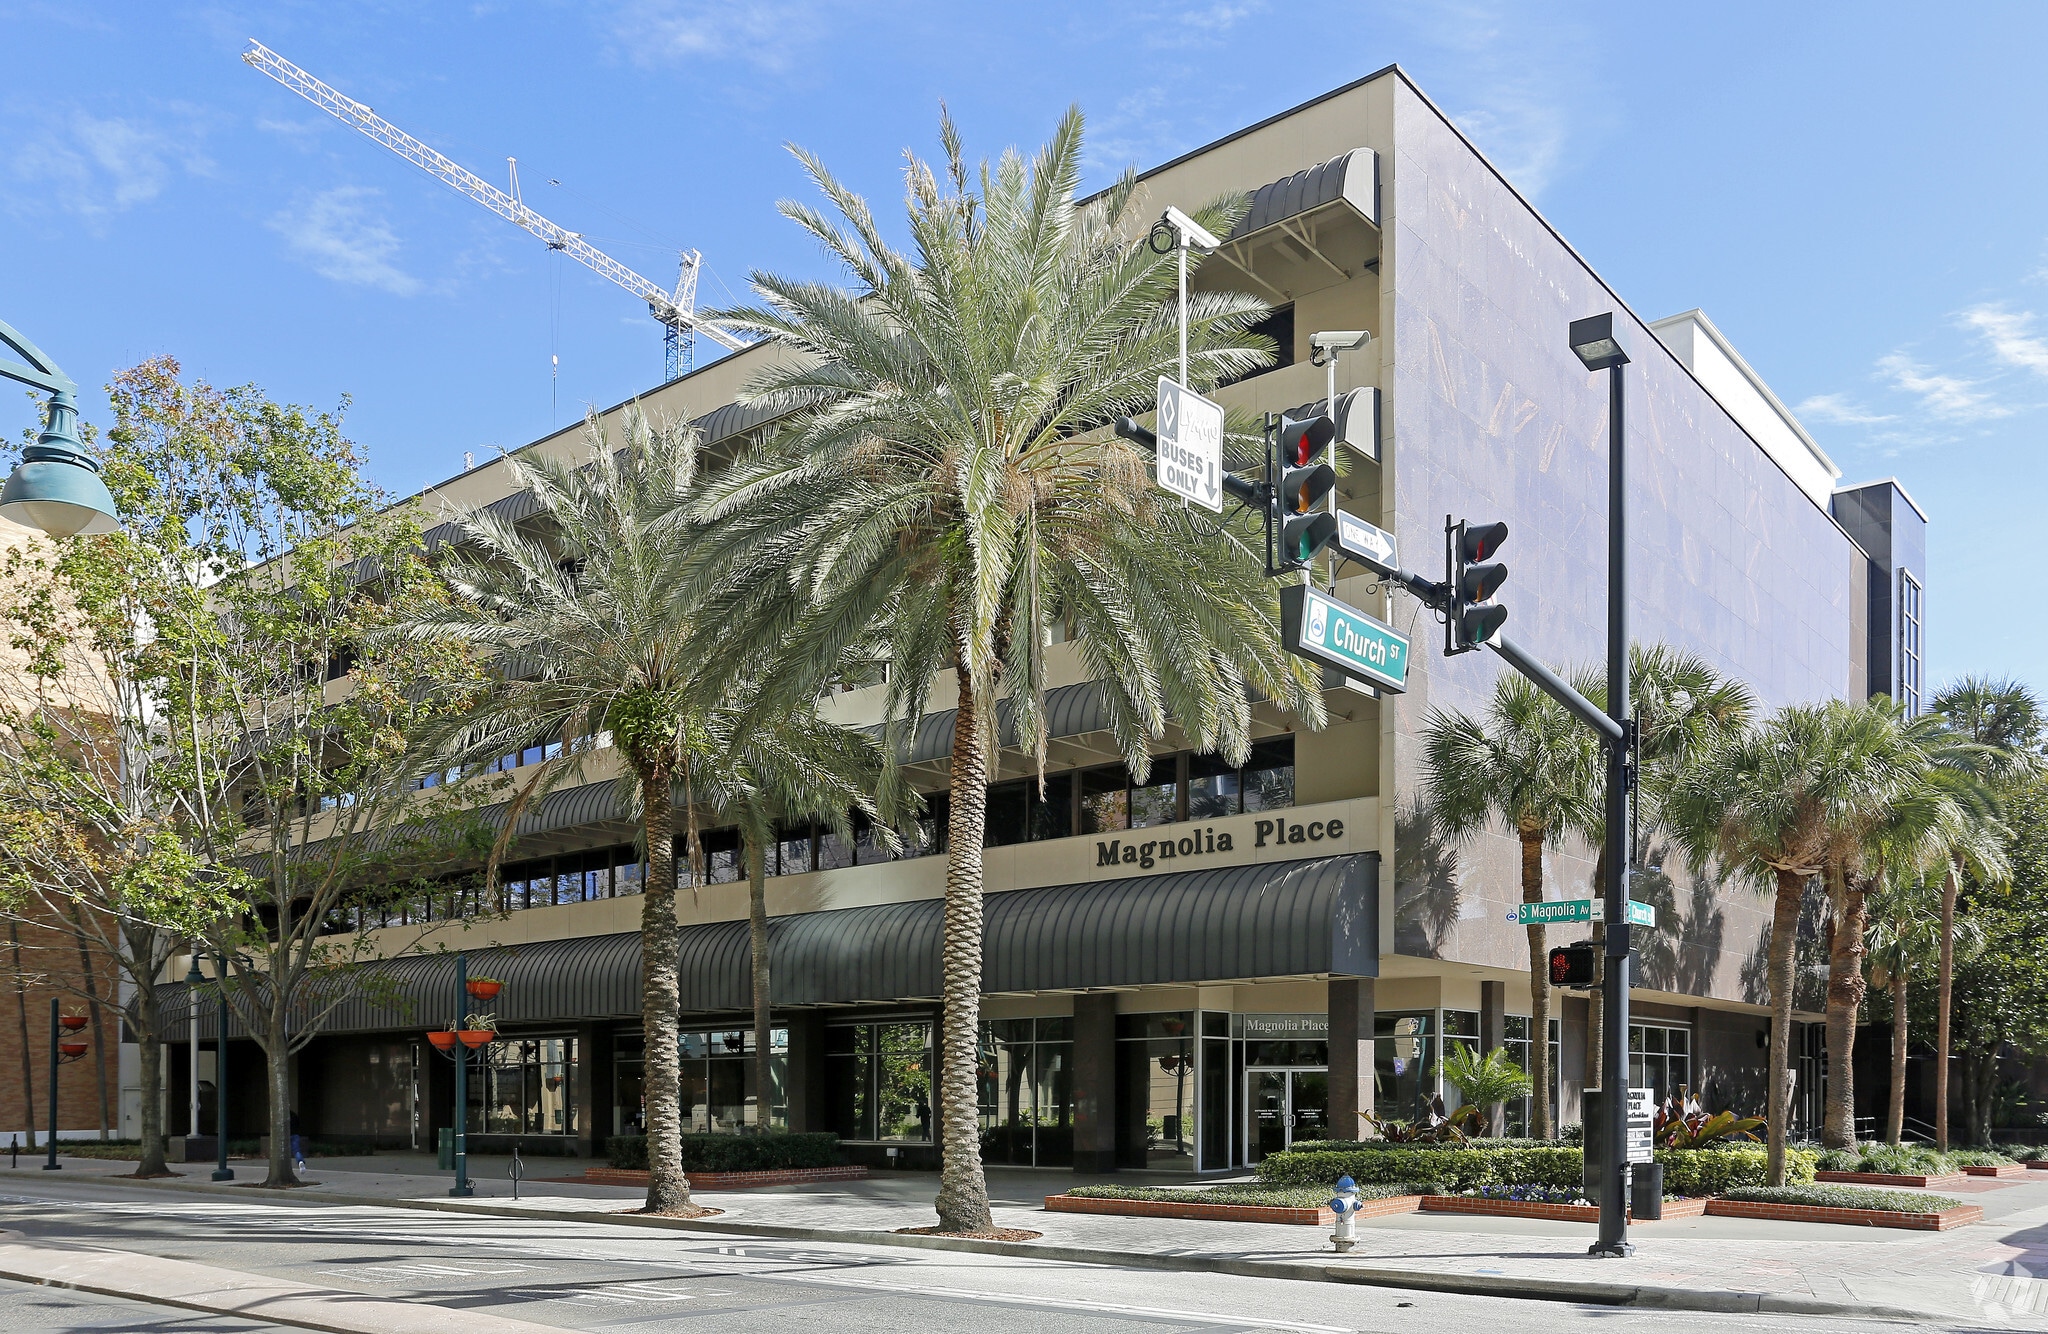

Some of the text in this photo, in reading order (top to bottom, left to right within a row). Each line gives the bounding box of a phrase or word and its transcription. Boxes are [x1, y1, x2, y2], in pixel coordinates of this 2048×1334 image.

[1162, 441, 1203, 474] BUSES
[1167, 465, 1198, 493] ONLY
[1345, 524, 1379, 552] ONE WAY
[1333, 617, 1400, 666] Church ST
[1097, 818, 1344, 869] Magnolia Place
[1520, 904, 1589, 921] S Magnolia Av
[1247, 1019, 1329, 1033] Magnolia Place
[1627, 1091, 1645, 1100] AGNOLIA
[1628, 1101, 1641, 1110] PLACE
